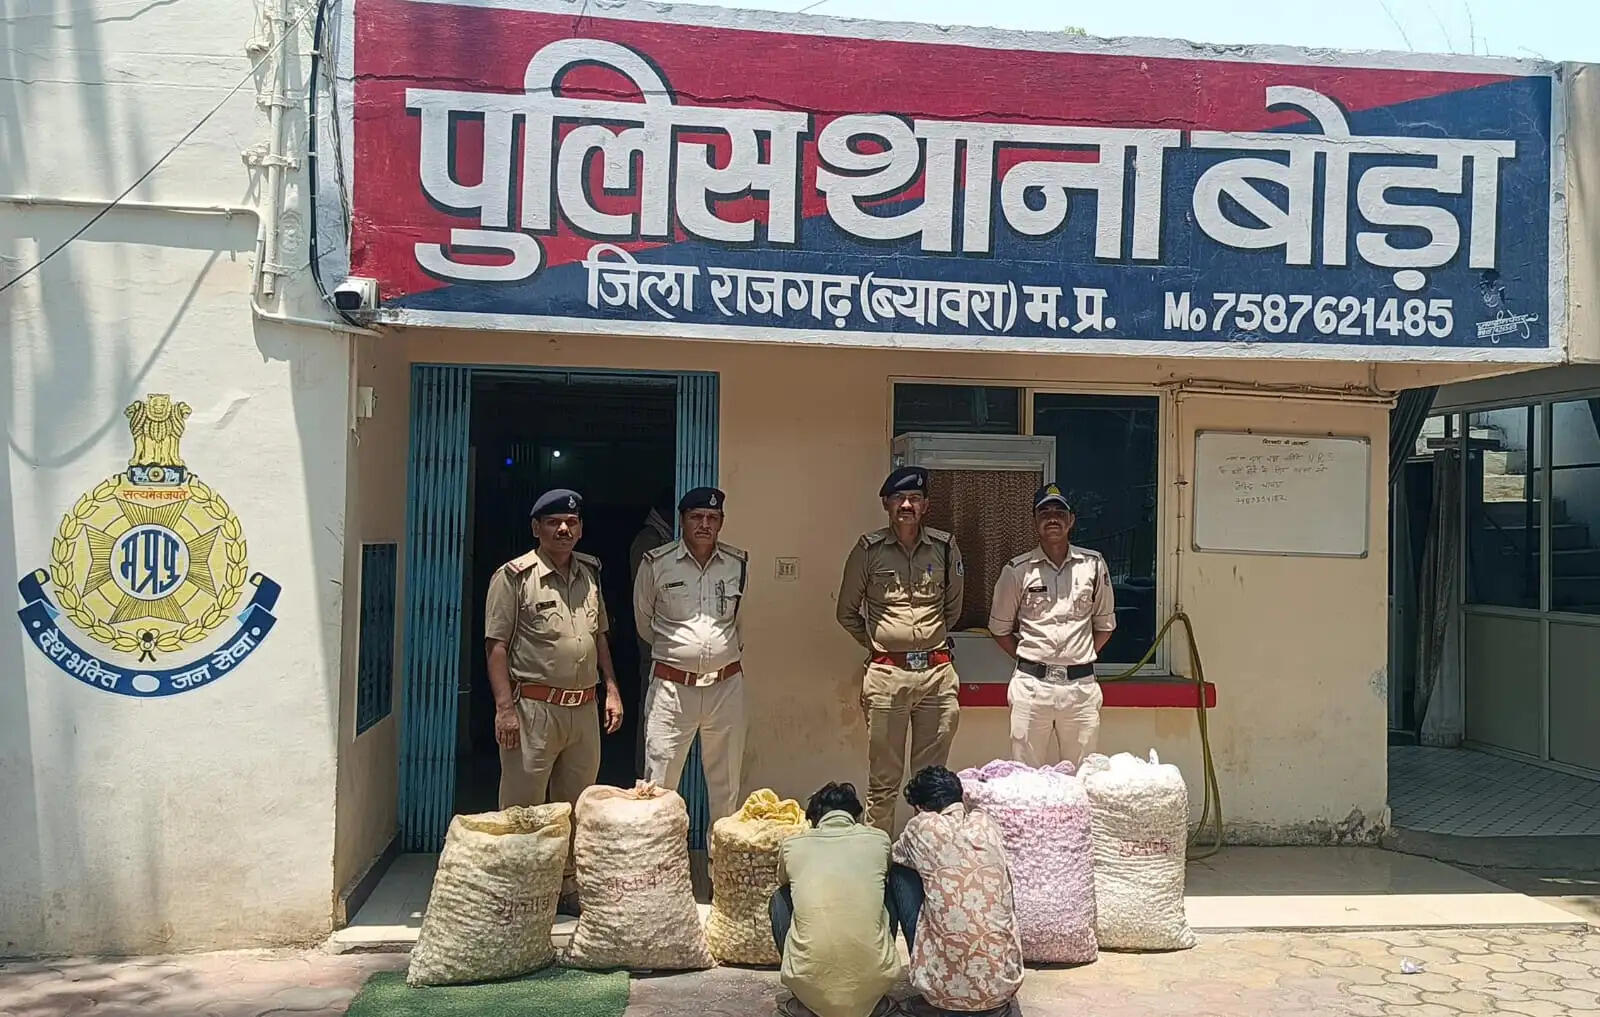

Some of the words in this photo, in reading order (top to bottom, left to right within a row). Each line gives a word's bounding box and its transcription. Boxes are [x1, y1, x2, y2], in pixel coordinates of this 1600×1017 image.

[405, 38, 809, 282] पुलिस
[815, 113, 1183, 260] थाना
[1190, 86, 1516, 291] बोड़ा
[582, 243, 700, 319] जिला
[1212, 293, 1454, 338] 7587621485
[170, 663, 211, 688] जन
[211, 632, 256, 670] सेवा
